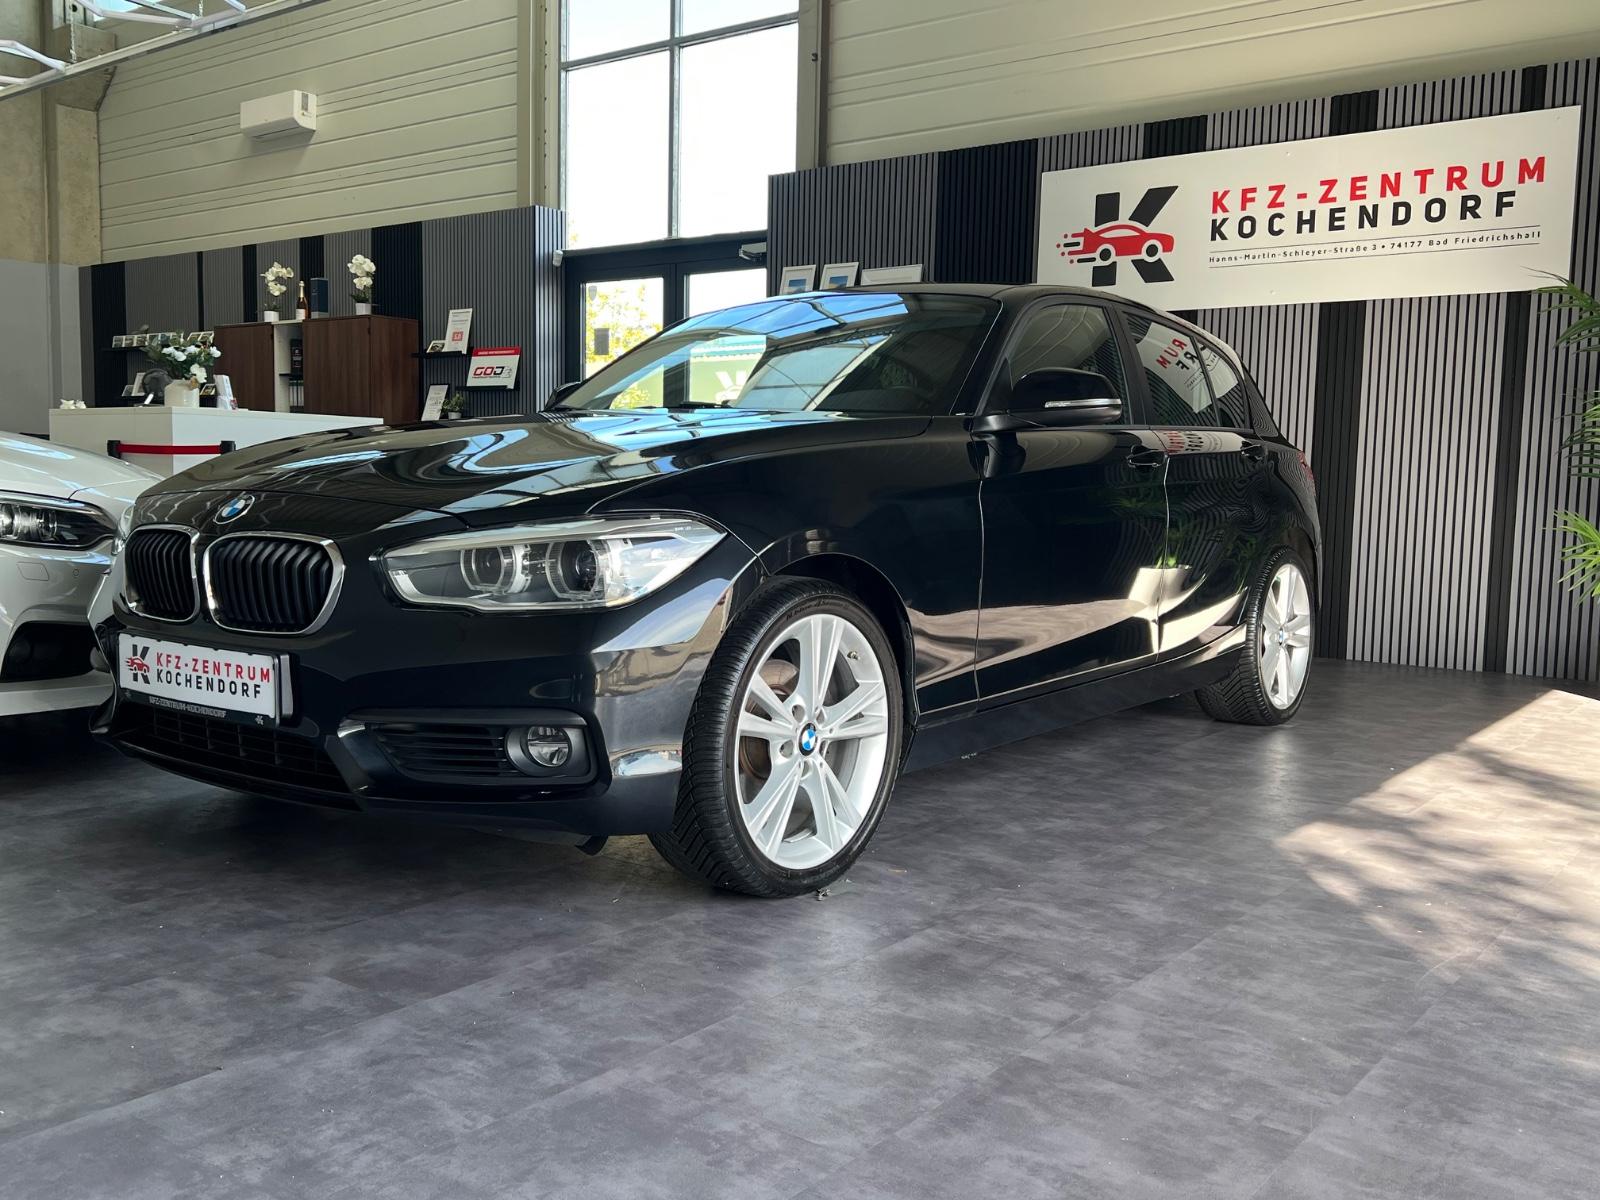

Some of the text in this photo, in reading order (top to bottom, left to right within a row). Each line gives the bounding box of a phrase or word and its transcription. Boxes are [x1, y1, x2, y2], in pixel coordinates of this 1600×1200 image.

[1210, 155, 1547, 215] KFZ-ZENTRUM
[1210, 190, 1517, 242] KOCHENDORF
[1208, 231, 1541, 264] Hanns-Martin-Schleyer-Straße 3 74177 Bad Friedrichshall
[156, 652, 271, 684] KFZ-ZENTRUM
[156, 668, 262, 699] KOCHENDORF
